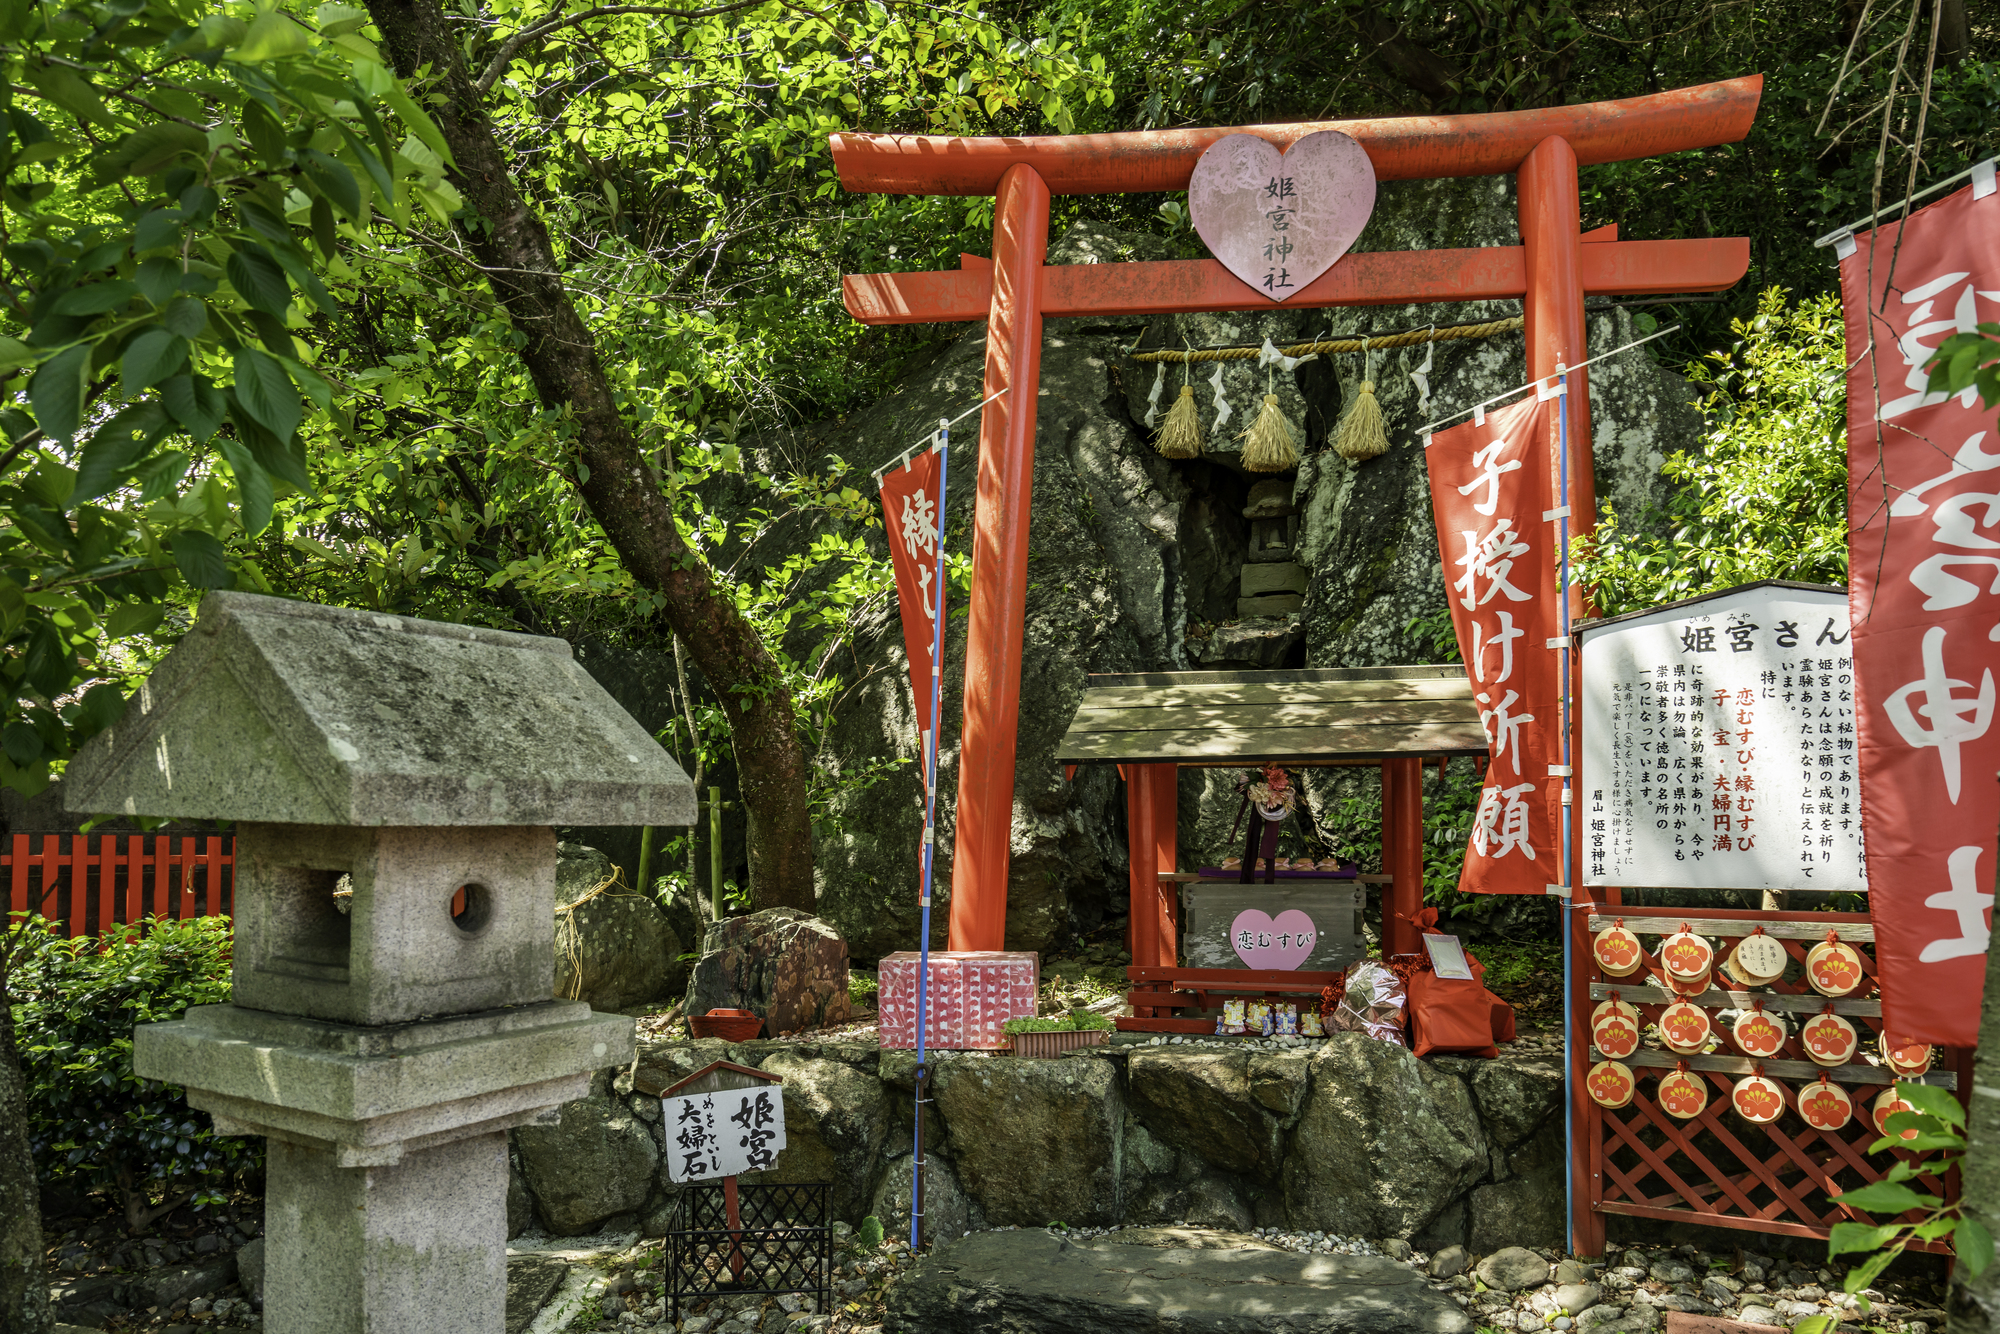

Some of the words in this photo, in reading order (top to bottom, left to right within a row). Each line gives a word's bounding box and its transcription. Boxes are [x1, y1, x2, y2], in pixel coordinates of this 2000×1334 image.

[1263, 177, 1298, 292] 姫宮神社
[1453, 438, 1536, 861] 子授け祈願
[1680, 617, 1850, 654] 姫宮さん
[1689, 614, 1711, 624] ひめ
[1727, 612, 1751, 621] みや
[1760, 670, 1777, 700] 特に
[1781, 661, 1796, 712] います。
[1639, 670, 1653, 807] 一つになっています。
[1655, 665, 1670, 830] 崇敬者多く徳島の名所の
[1798, 658, 1815, 878] 霊験あらたかなりと伝えられて
[1818, 658, 1834, 864] 姫宮さんは念願の成就を祈り
[1837, 656, 1855, 840] 例のない秘物であります。
[1238, 930, 1314, 950] 恋むすび
[676, 1099, 708, 1177] 夫婦石
[731, 1091, 776, 1167] 姫宮
